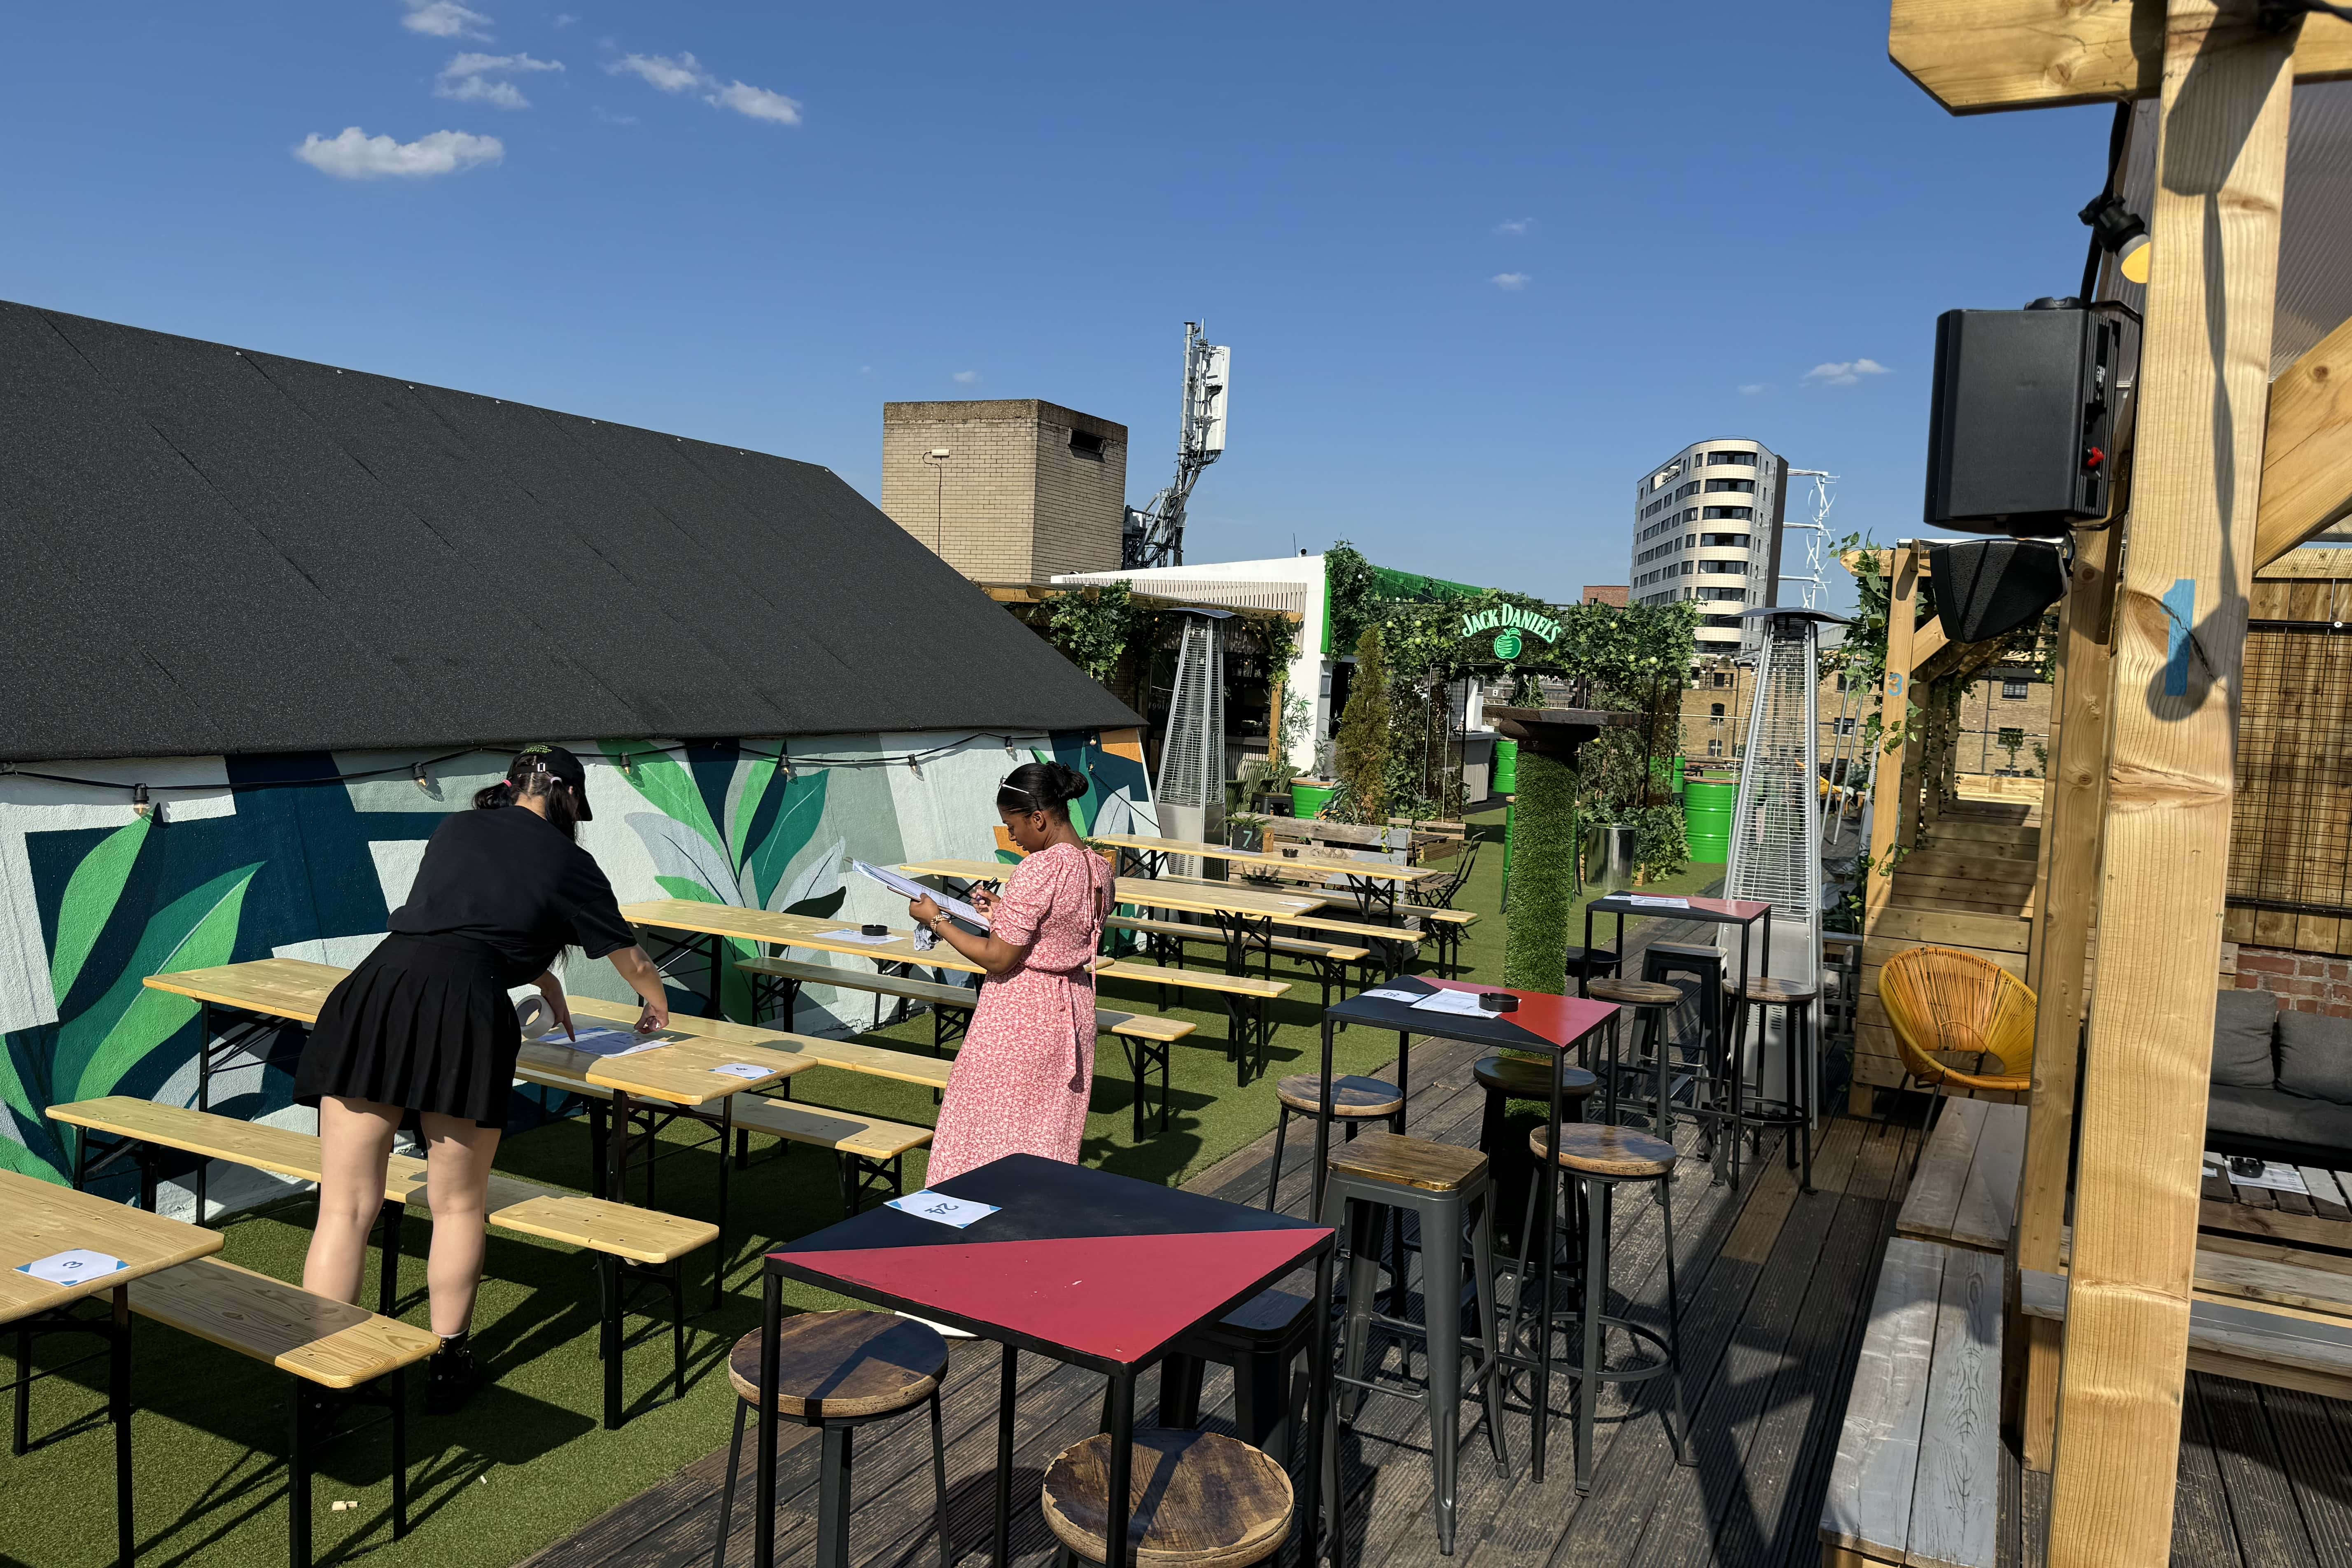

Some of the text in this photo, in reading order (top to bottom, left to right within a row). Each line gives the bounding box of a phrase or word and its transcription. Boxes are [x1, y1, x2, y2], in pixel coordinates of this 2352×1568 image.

[1462, 603, 1562, 644] JACK DANIEL'S
[1888, 672, 1903, 696] 3
[1243, 830, 1253, 847] 7
[924, 1202, 959, 1215] 24
